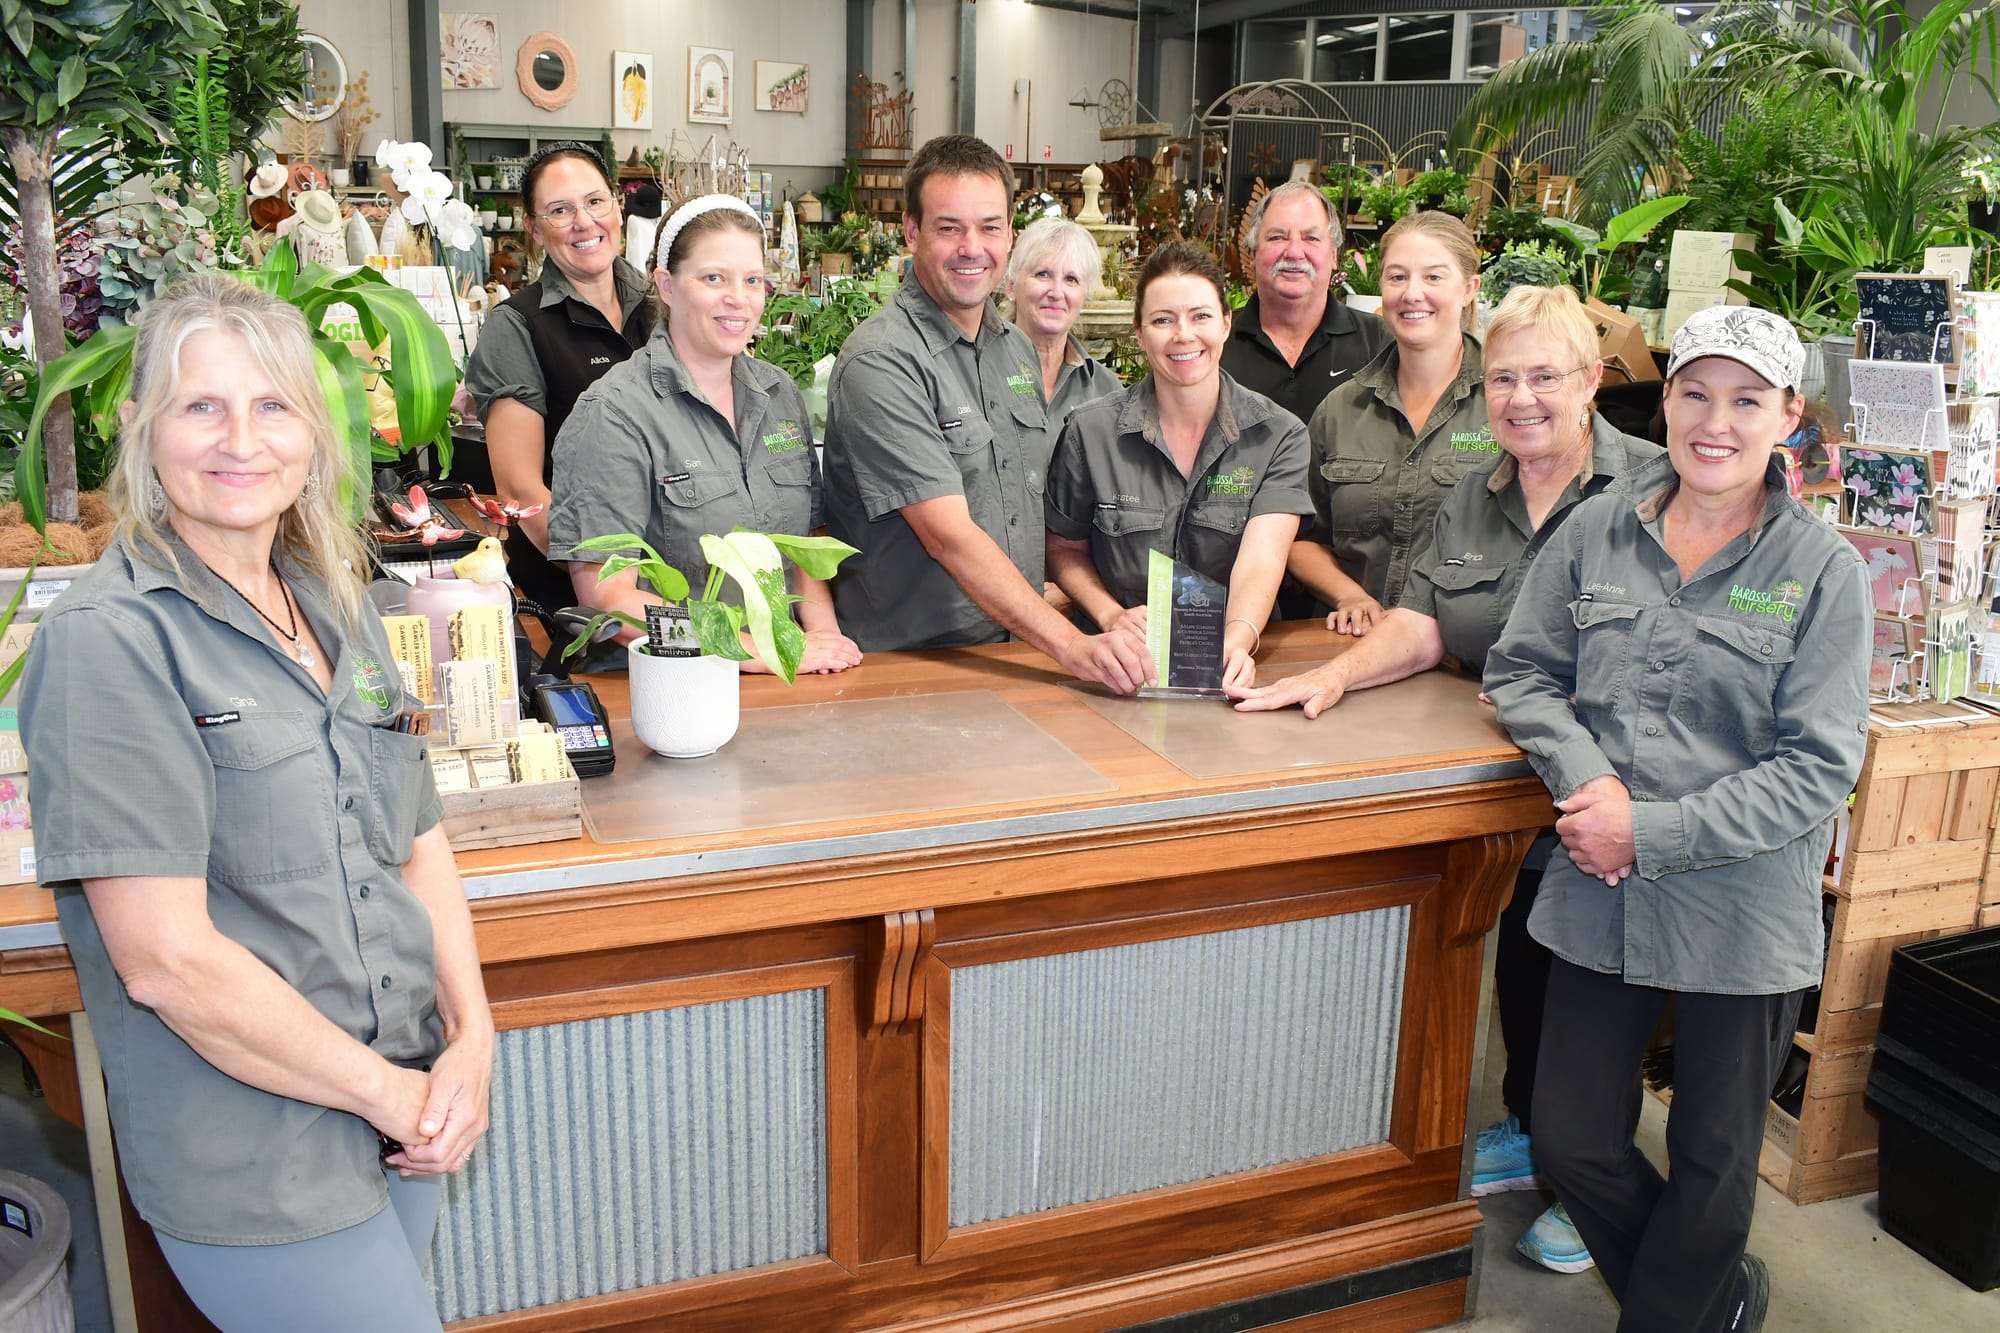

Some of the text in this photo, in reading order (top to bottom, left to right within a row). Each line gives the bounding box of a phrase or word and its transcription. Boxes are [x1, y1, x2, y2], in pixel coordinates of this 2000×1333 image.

[1451, 432, 1481, 442] BAROSSA
[1450, 441, 1500, 454] nursery
[1206, 484, 1251, 497] nursery
[1729, 584, 1772, 604] BAROSSA
[1727, 596, 1796, 622] nursery
[497, 609, 506, 635] GAWLER
[399, 624, 408, 653] GAWLER
[412, 624, 421, 650] GAWLER
[498, 637, 506, 655] SWEET
[658, 648, 692, 657] enliven
[485, 664, 493, 690] GAWLER
